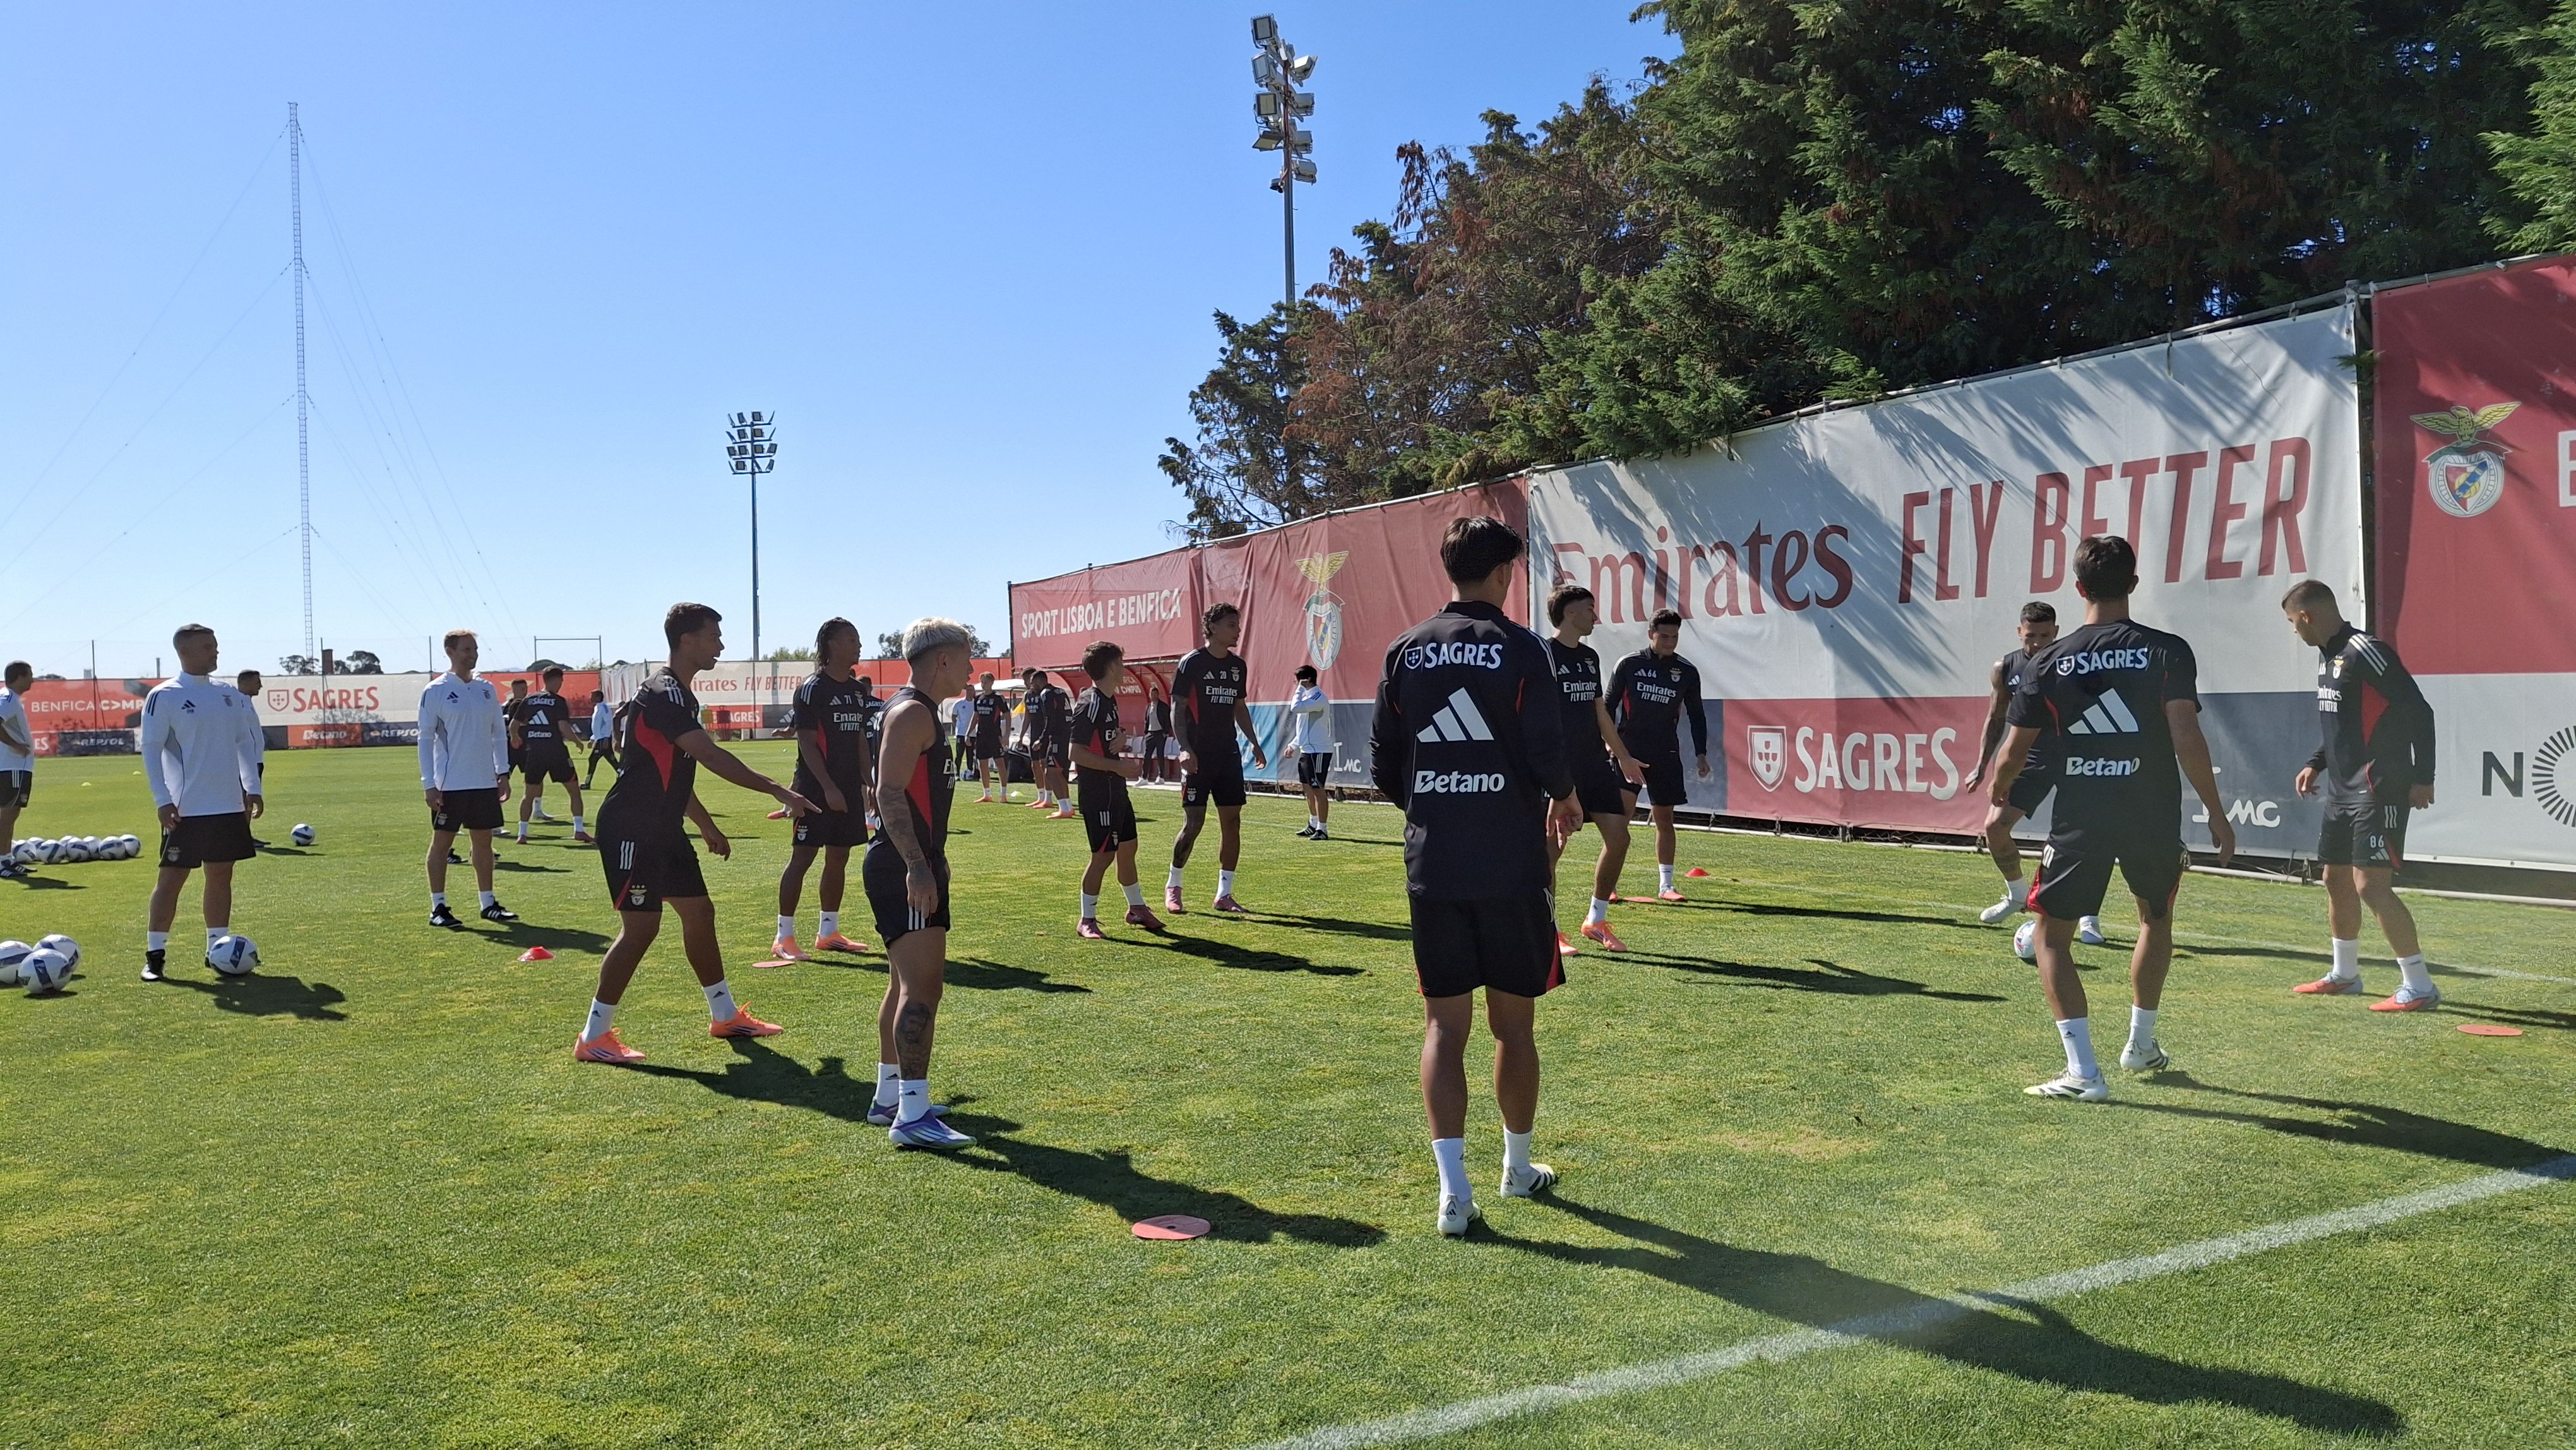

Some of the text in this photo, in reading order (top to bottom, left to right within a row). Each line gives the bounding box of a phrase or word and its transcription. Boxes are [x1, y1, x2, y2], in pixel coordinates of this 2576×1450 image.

[1899, 480, 2004, 603] FLY
[2029, 436, 2311, 594] BETTER
[1022, 587, 1181, 638] SPORT LISBOA E BENFICA
[1424, 642, 1502, 669] SAGRES
[2077, 647, 2147, 674] SAGRES
[1219, 671, 1227, 680] 20
[1647, 669, 1657, 678] 64
[694, 678, 737, 692] irates
[744, 676, 762, 691] FLY
[1563, 681, 1597, 693] Emirate
[1637, 681, 1677, 698] Emirates
[1205, 686, 1237, 697] Emirates
[1570, 692, 1580, 702] FLY
[2318, 685, 2342, 702] mirates
[293, 686, 379, 712] SAGRES
[844, 695, 852, 704] 71
[1642, 692, 1670, 705] FLY BETTER
[32, 700, 95, 712] BENFICA
[730, 710, 760, 723] AGRES
[302, 729, 347, 740] Betano
[381, 729, 419, 738] REPSO
[81, 738, 124, 746] REPSOL
[1794, 726, 1959, 801] SAGRES
[2065, 757, 2140, 776] Betano
[1414, 770, 1505, 794] Betano
[2370, 835, 2384, 849] 86
